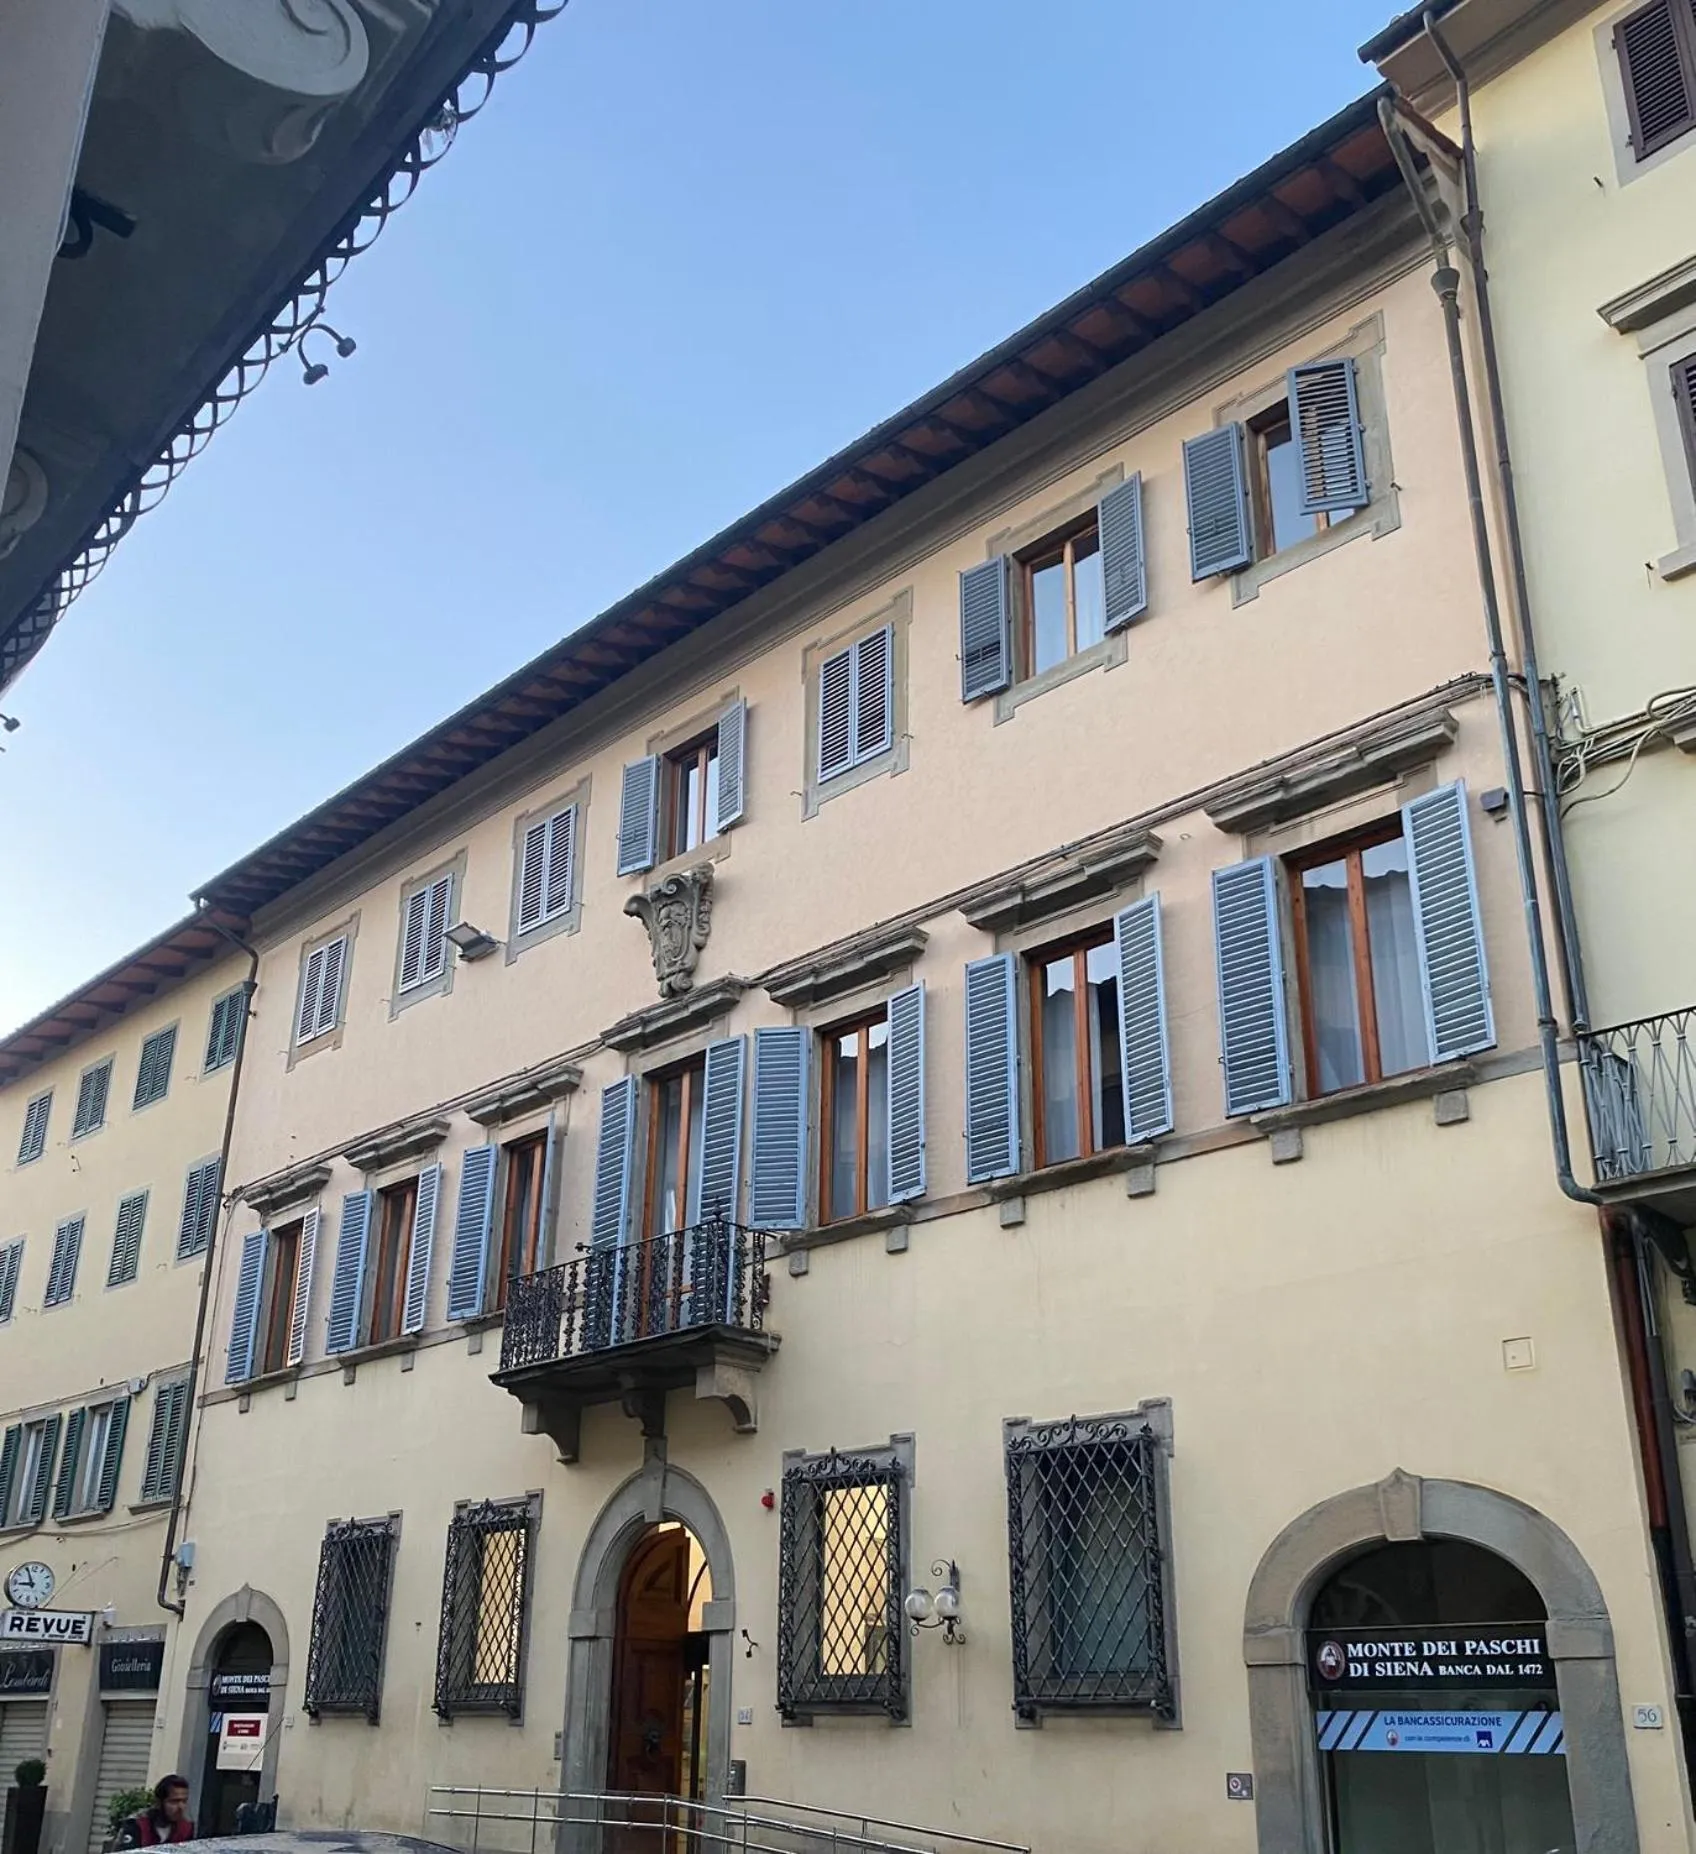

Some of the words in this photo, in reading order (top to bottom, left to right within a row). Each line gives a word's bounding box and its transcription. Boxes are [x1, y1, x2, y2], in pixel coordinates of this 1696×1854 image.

[9, 1616, 86, 1635] REVUE
[1346, 1641, 1416, 1658] MONTE
[1422, 1641, 1458, 1656] DEI
[1464, 1639, 1542, 1655] PASCHI
[1349, 1663, 1370, 1678] DI
[1375, 1661, 1434, 1677] SIENA
[1438, 1665, 1482, 1676] BANCA
[1486, 1664, 1514, 1675] DAL
[1518, 1664, 1544, 1675] 1472
[1384, 1716, 1396, 1726] LA
[1397, 1716, 1503, 1727] BANCASSICURAZIONE
[1637, 1708, 1657, 1723] 56
